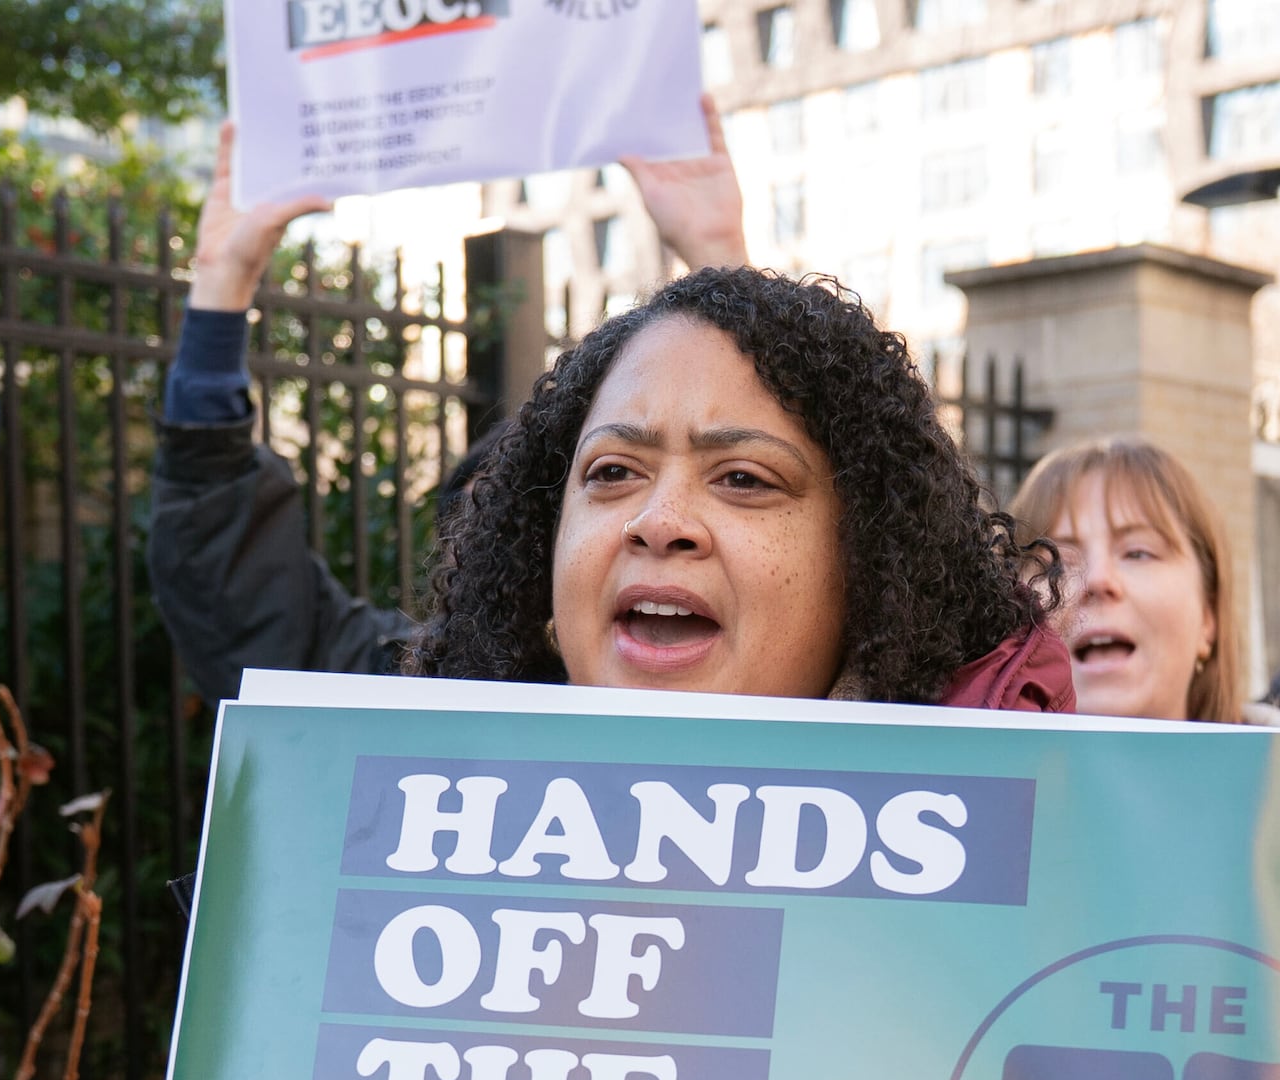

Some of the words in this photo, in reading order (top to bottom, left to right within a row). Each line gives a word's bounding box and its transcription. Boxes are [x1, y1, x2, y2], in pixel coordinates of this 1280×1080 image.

[385, 773, 968, 895] HANDS
[373, 904, 685, 1019] OFF
[1100, 981, 1248, 1035] THE
